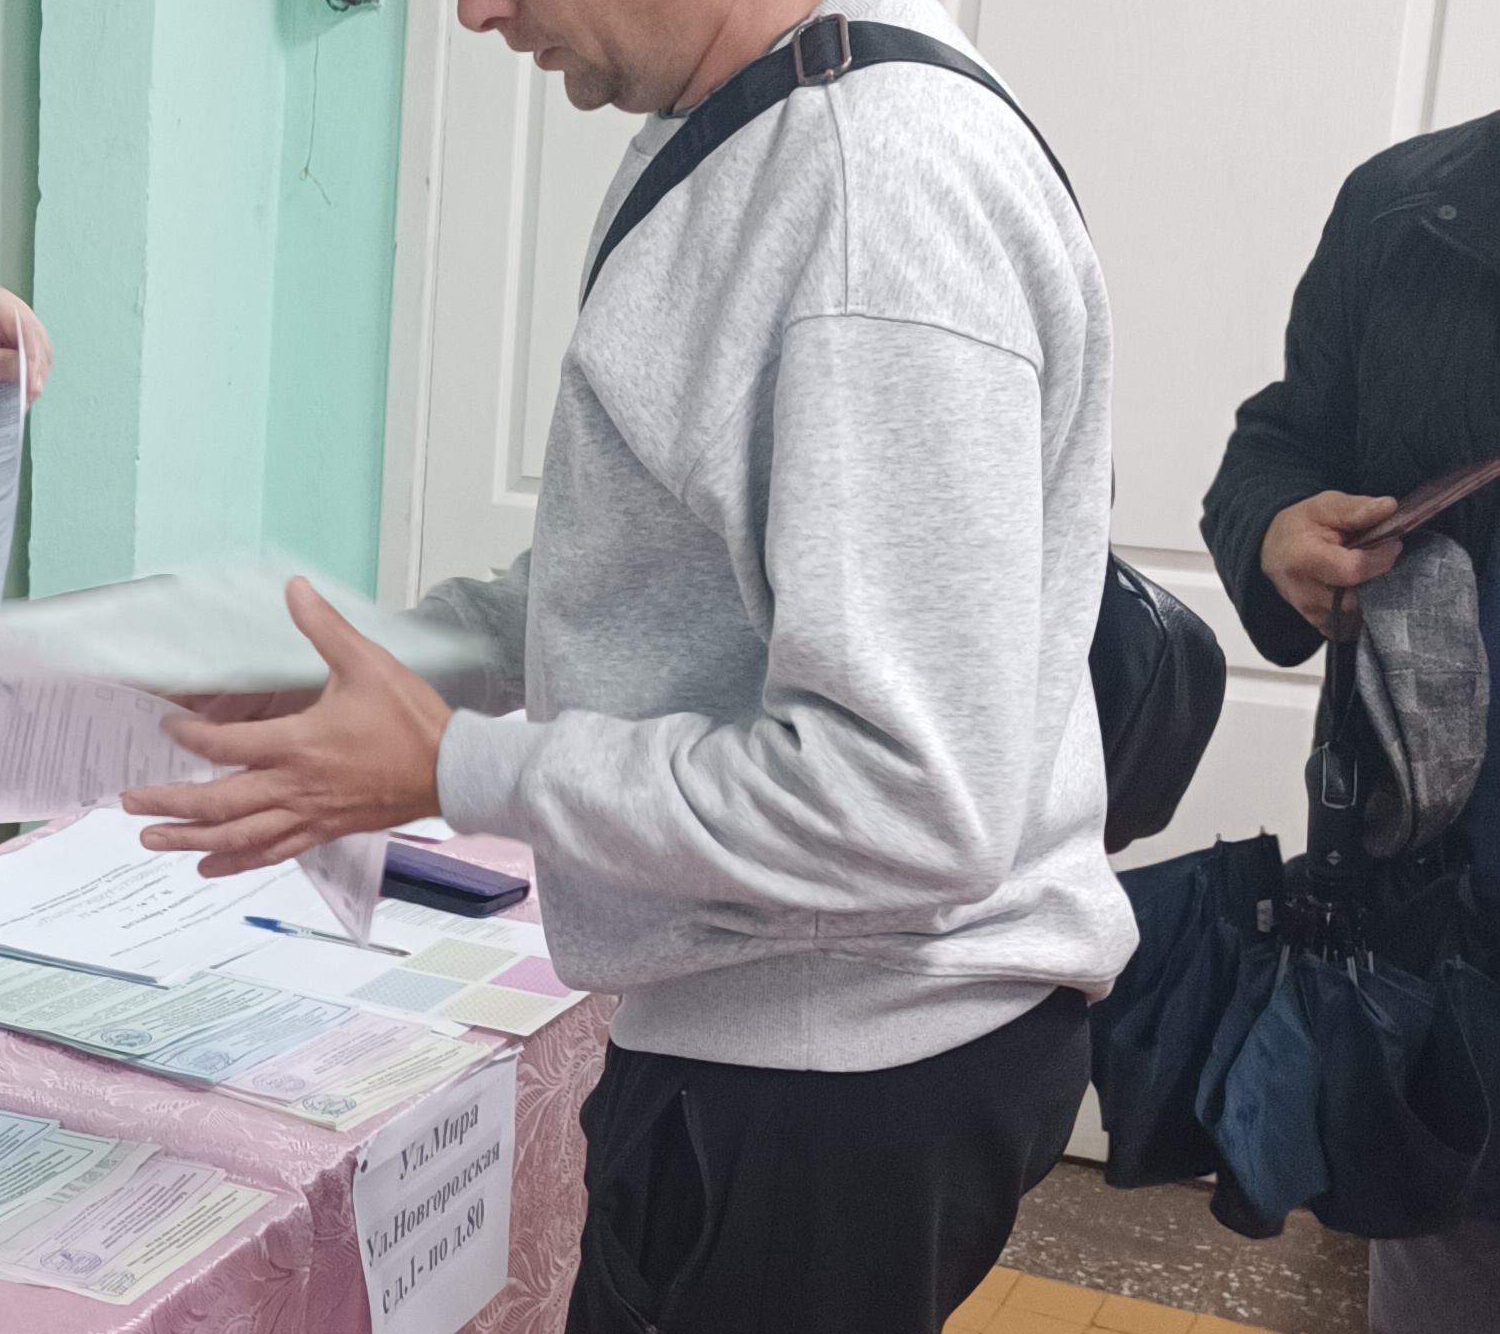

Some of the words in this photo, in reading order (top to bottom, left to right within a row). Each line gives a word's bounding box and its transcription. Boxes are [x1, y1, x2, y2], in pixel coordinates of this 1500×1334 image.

[400, 1103, 479, 1181] Ул.Мира
[366, 1140, 500, 1268] Ул.Новгородская
[428, 1234, 448, 1273] по
[453, 1197, 485, 1253] д.80
